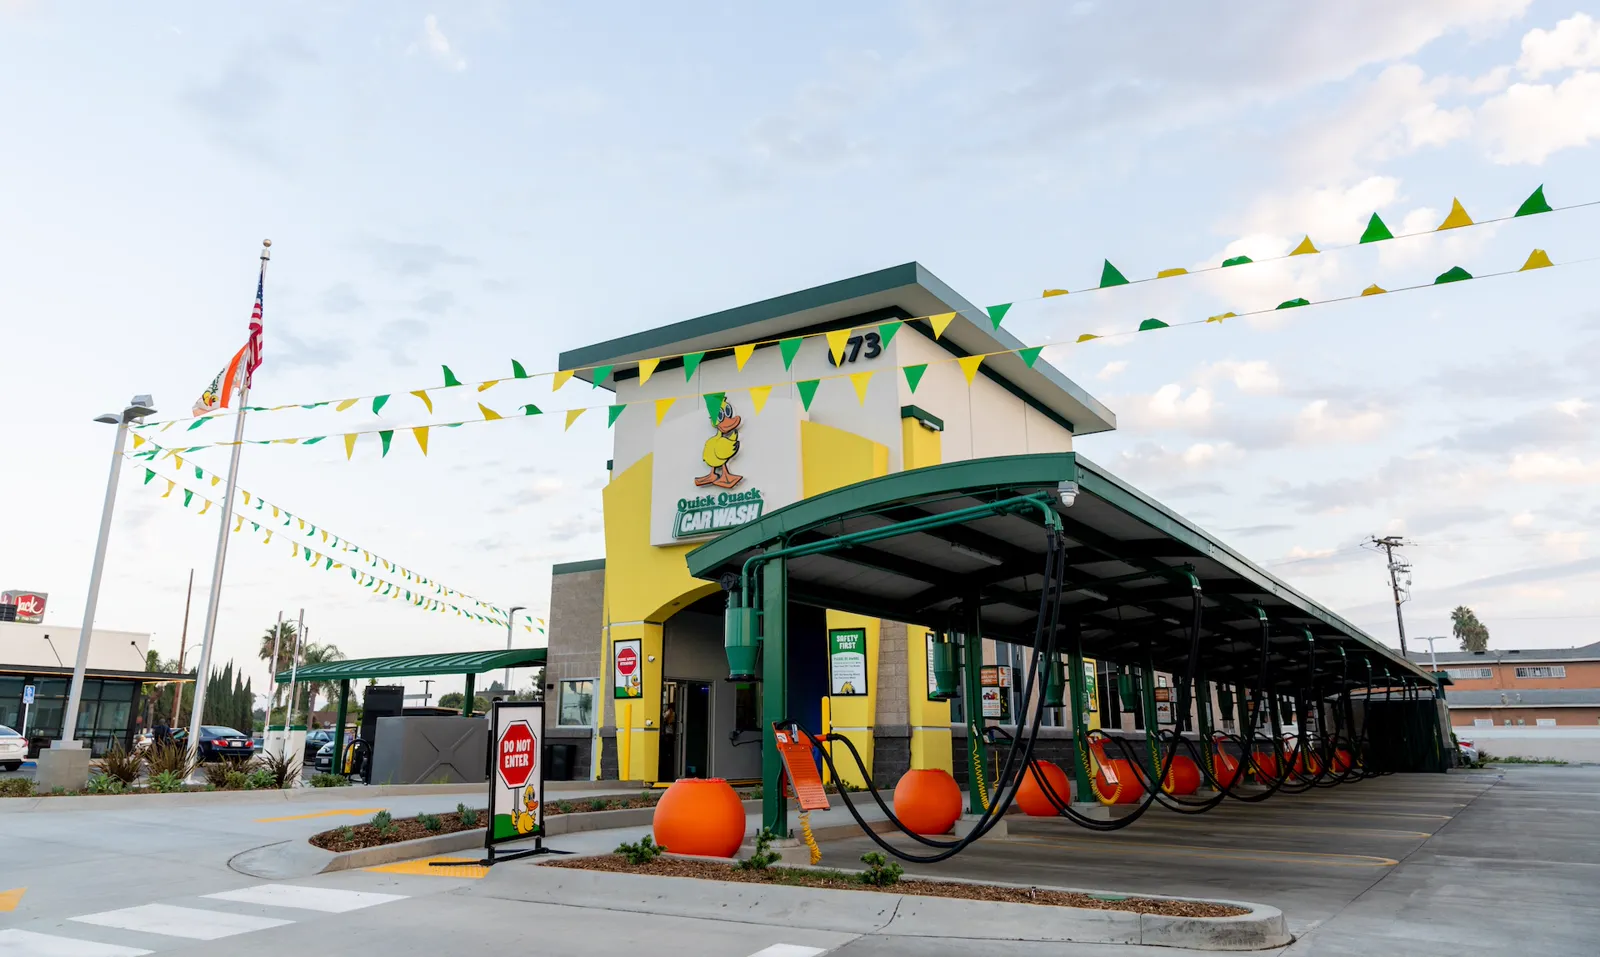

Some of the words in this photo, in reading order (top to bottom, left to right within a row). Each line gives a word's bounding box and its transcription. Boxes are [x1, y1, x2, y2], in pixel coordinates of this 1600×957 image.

[677, 494, 715, 512] Quick
[718, 487, 761, 506] Quack
[680, 510, 713, 532] CAR
[713, 503, 760, 528] WASH
[17, 596, 44, 614] Jack
[836, 634, 858, 643] SAFETY
[839, 642, 856, 650] FIRST
[503, 740, 515, 753] DO
[516, 739, 531, 752] NOT
[505, 753, 529, 768] ENTER
